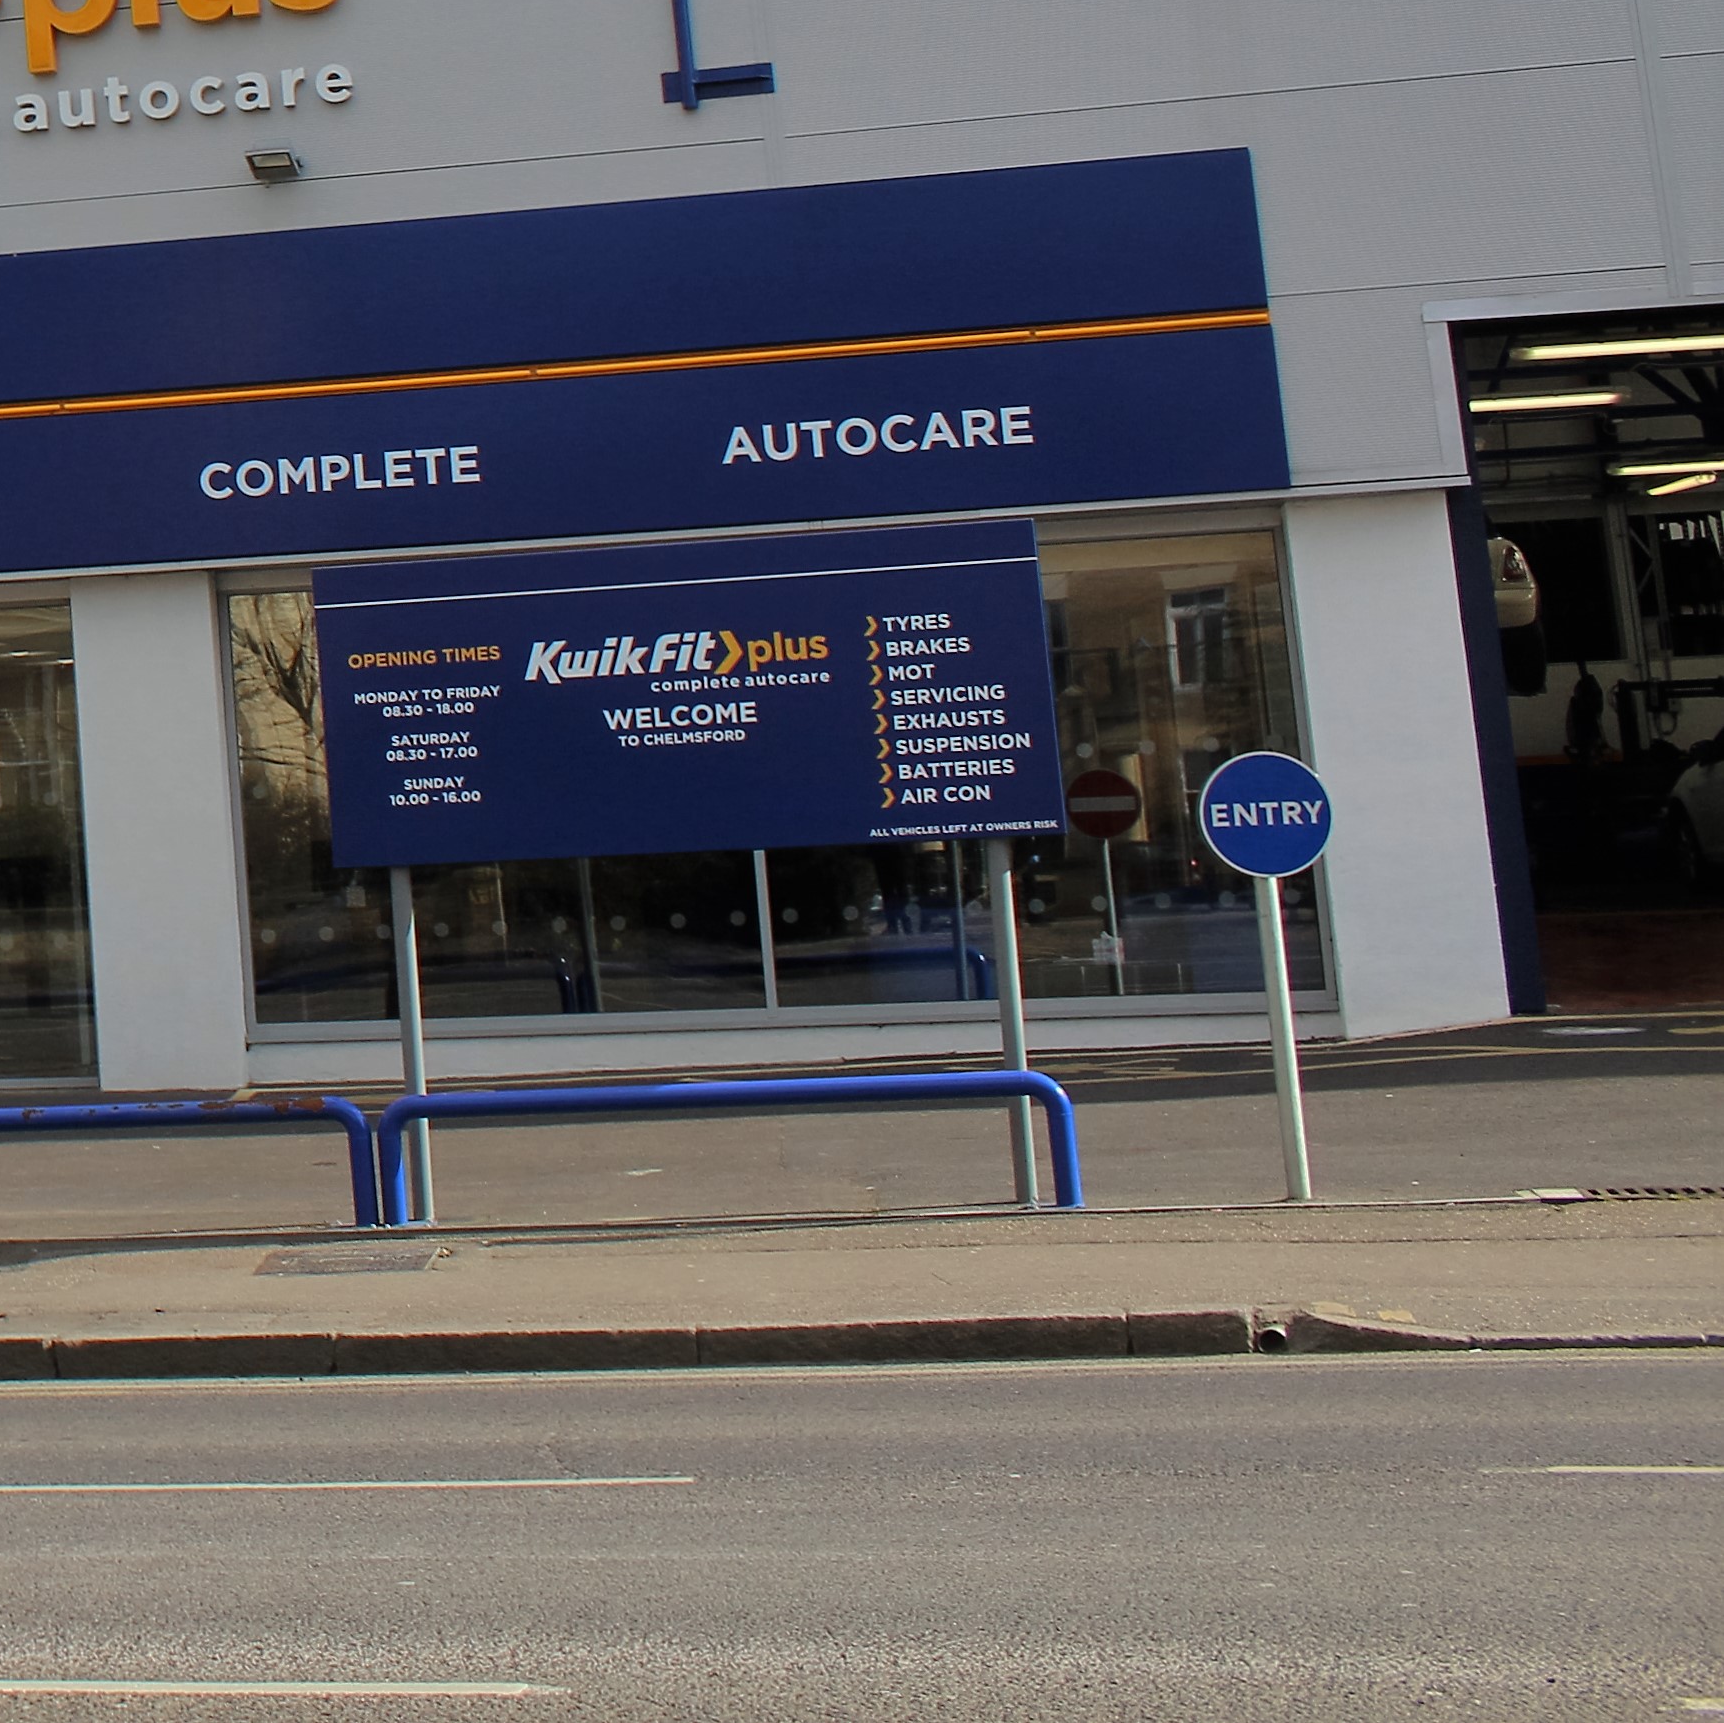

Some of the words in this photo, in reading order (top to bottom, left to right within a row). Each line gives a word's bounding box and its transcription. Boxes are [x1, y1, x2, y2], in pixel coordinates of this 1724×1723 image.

[13, 64, 353, 132] autocare
[199, 445, 481, 501] COMPLETE
[722, 405, 1035, 466] AUTOCARE
[883, 613, 951, 632] TYRES
[747, 631, 829, 672] plus
[885, 637, 971, 657] BRAKES
[348, 649, 437, 669] OPENING
[442, 646, 501, 663] TIMES
[650, 675, 740, 693] complete
[744, 671, 830, 688] autocare
[888, 663, 936, 682] MOT
[354, 689, 418, 704] MONDAY
[422, 688, 443, 701] TO
[447, 685, 500, 699] FRIDAY
[890, 684, 1006, 706] SERVICING
[382, 704, 423, 718] 08.30
[436, 702, 475, 715] 18.00
[603, 701, 758, 730] WELCOME
[893, 709, 1006, 730] EXHAUSTS
[391, 731, 470, 747] SATURDAY
[618, 734, 639, 747] TO
[643, 729, 746, 746] CHELMSFORD
[895, 732, 1032, 755] SUSPENSION
[385, 749, 427, 762] 08.30
[440, 746, 478, 759] 17.00
[898, 758, 1015, 780] BATTERIES
[403, 776, 465, 791] SUNDAY
[389, 793, 429, 806] 10.00
[442, 790, 482, 804] 16.00
[901, 787, 938, 804] AIR
[943, 784, 992, 802] CON
[1210, 800, 1322, 827] ENTRY
[870, 828, 889, 837] ALL
[892, 825, 940, 836] VEHICLES
[942, 824, 967, 833] LEFT
[970, 823, 984, 832] AT
[986, 820, 1032, 831] OWNERS
[1034, 819, 1058, 828] RISK
